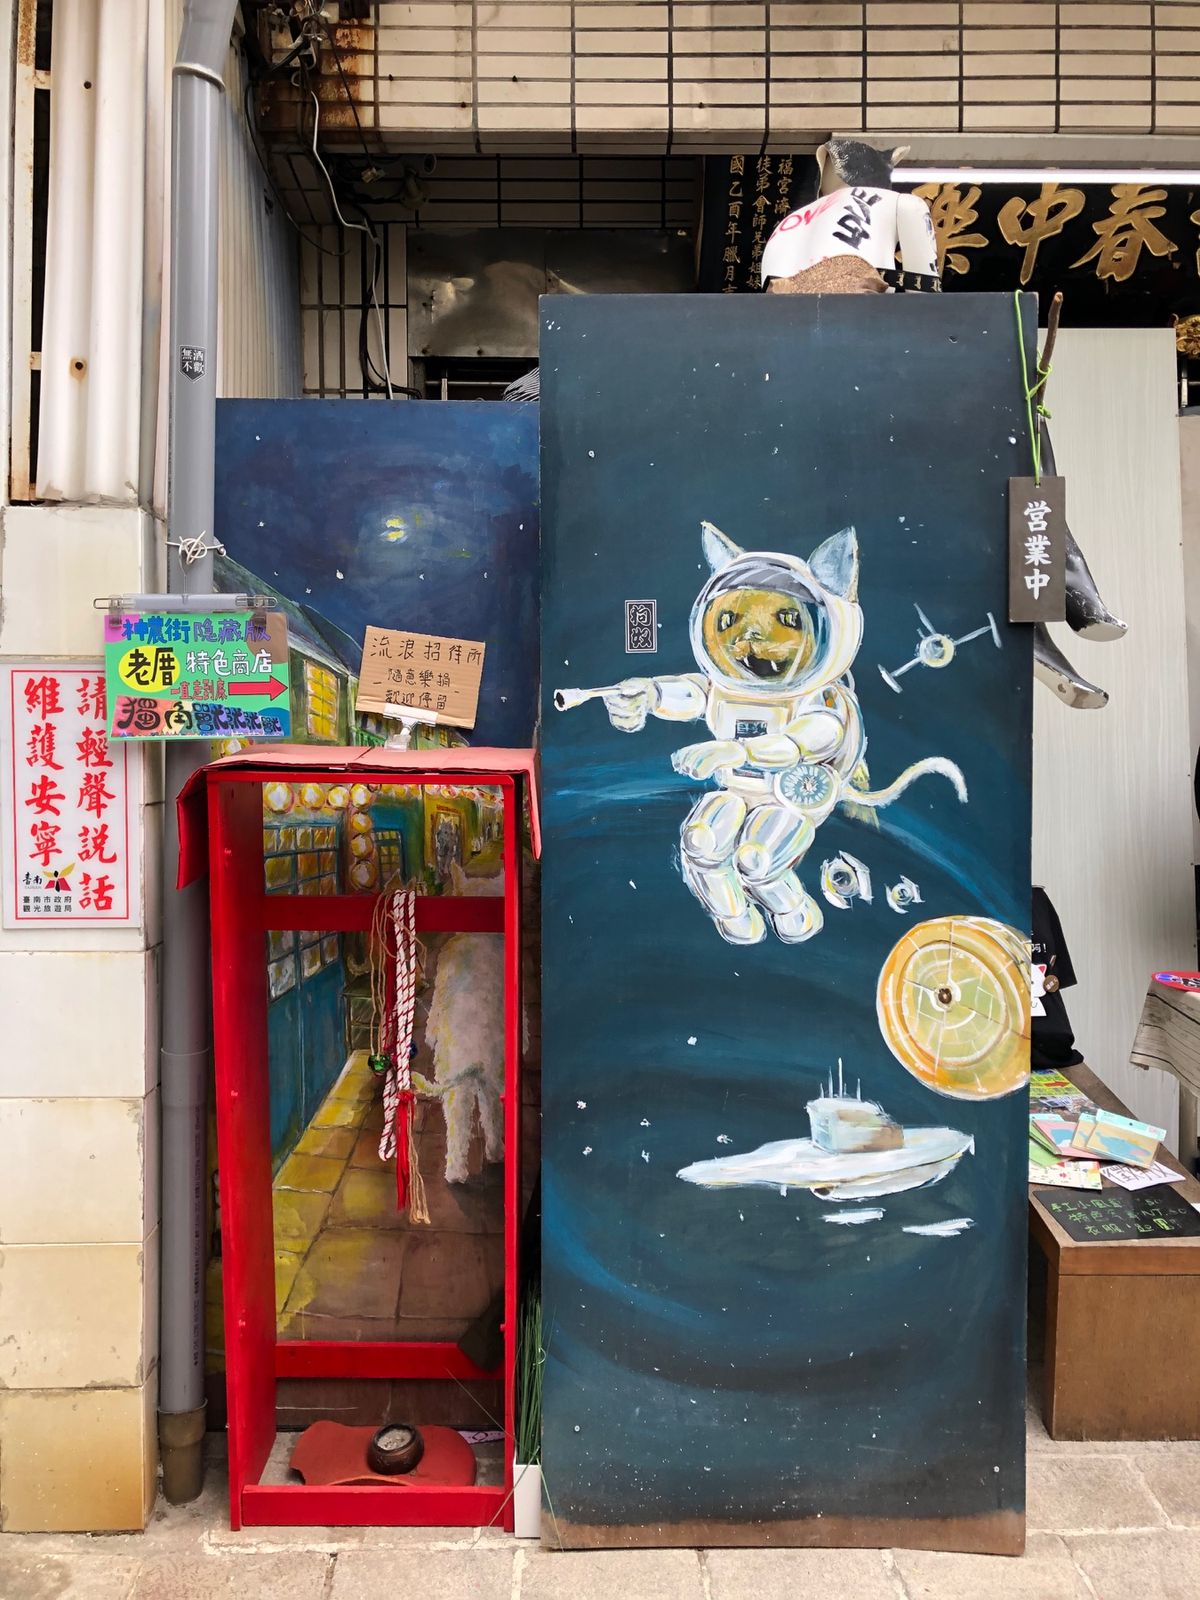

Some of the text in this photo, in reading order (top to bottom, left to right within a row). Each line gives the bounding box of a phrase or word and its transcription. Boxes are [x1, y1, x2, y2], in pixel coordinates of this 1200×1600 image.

[370, 635, 482, 666] 流浪招待所
[125, 647, 273, 686] 老厝 特色商店
[387, 667, 451, 688] 隨意樂捐
[385, 689, 447, 710] 歡迎停留
[24, 675, 66, 867] 維護安寧
[23, 895, 72, 903] 臺南市政府
[23, 904, 72, 913] 觀光旅遊局
